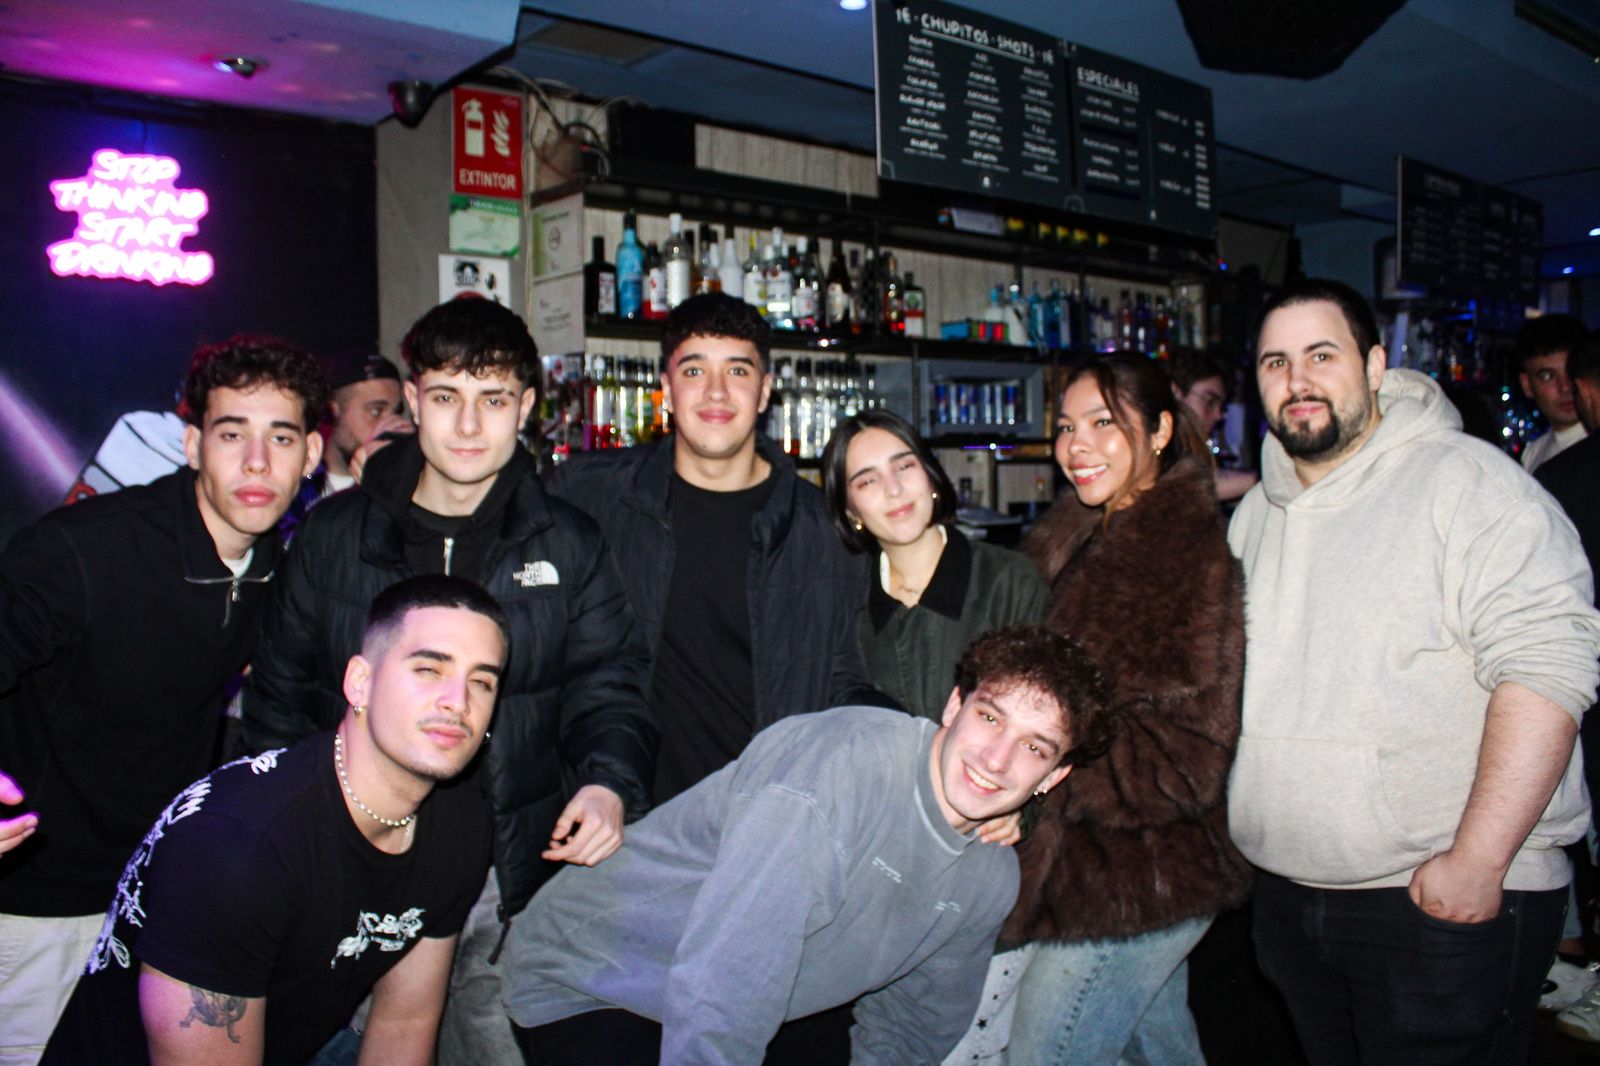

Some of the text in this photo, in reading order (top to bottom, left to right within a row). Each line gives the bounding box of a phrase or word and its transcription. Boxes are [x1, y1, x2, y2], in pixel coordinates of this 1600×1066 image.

[920, 12, 989, 45] CHUPITOS
[997, 34, 1035, 58] SHOTS
[1077, 66, 1140, 97] ESPECIALES
[93, 150, 178, 184] STOP
[459, 168, 516, 190] EXTINTOR
[79, 210, 196, 248] START
